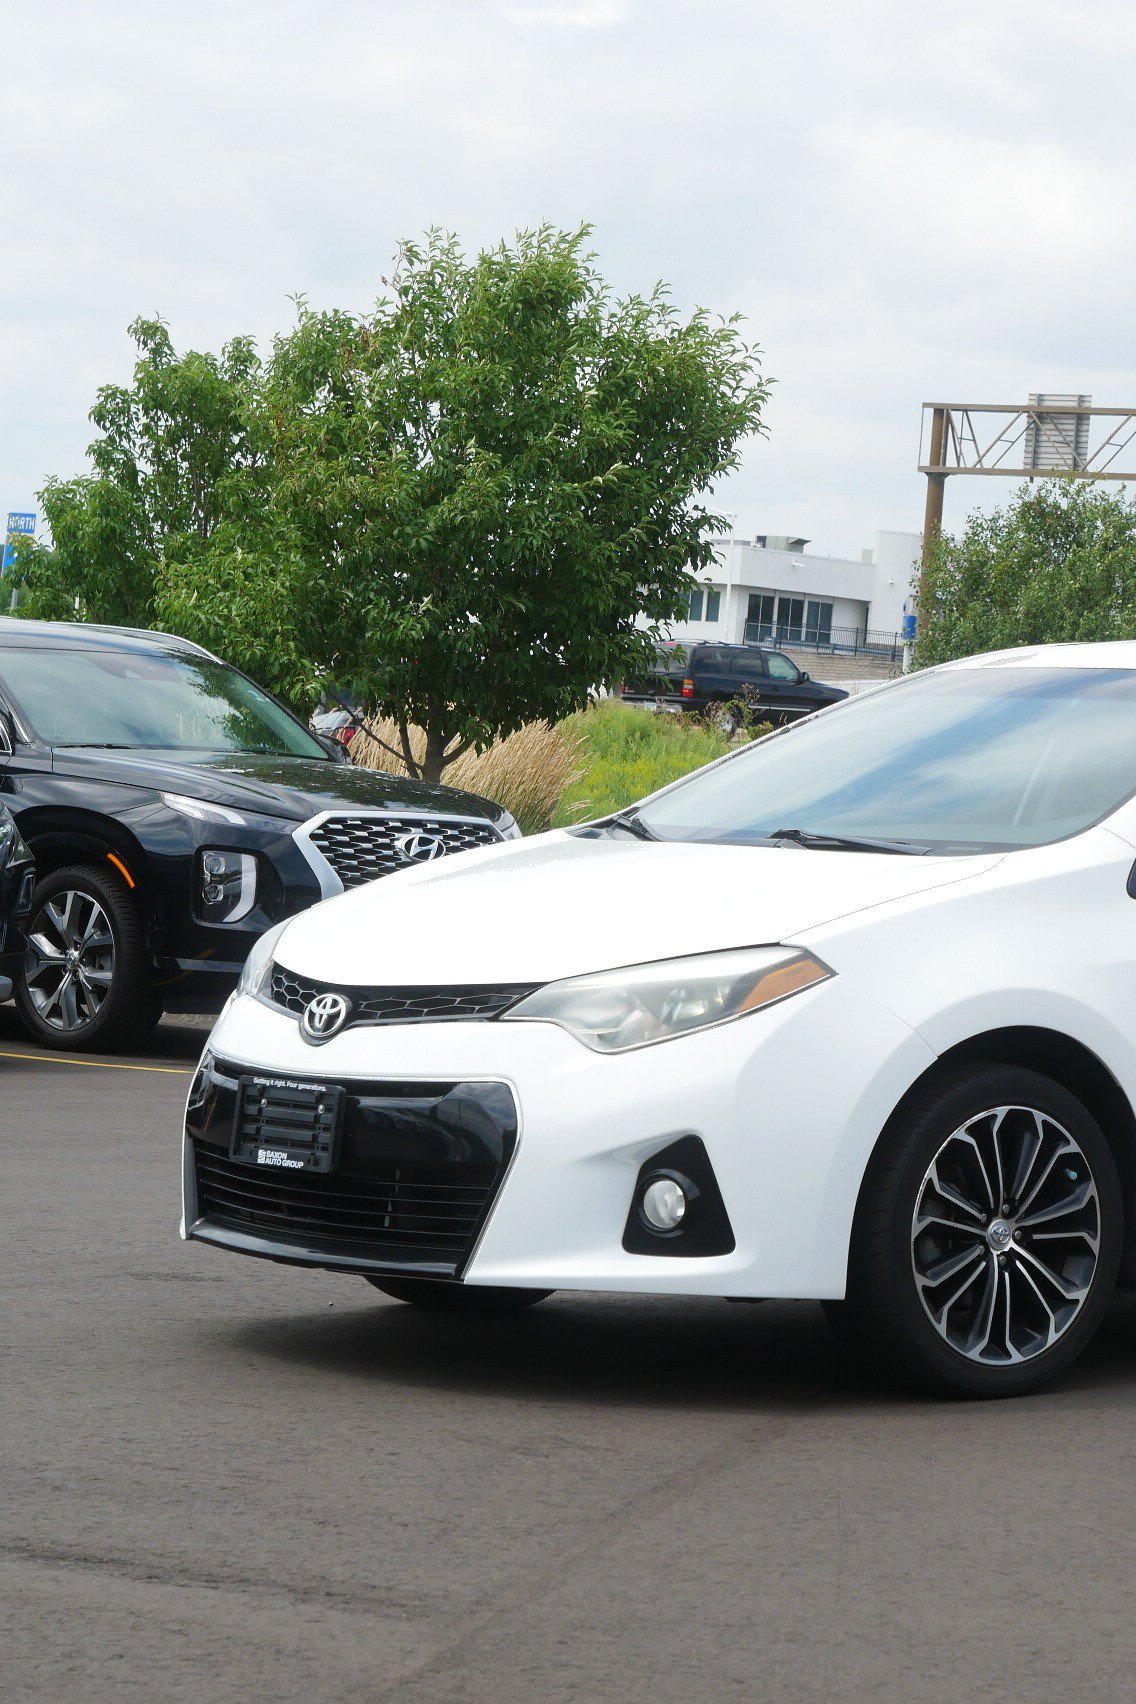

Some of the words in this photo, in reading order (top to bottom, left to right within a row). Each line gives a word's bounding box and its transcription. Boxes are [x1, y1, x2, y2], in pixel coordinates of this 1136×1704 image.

[253, 1077, 270, 1086] Getting
[266, 1150, 288, 1160] SAXON
[265, 1158, 282, 1166] AUTO
[281, 1160, 304, 1168] GROUP
